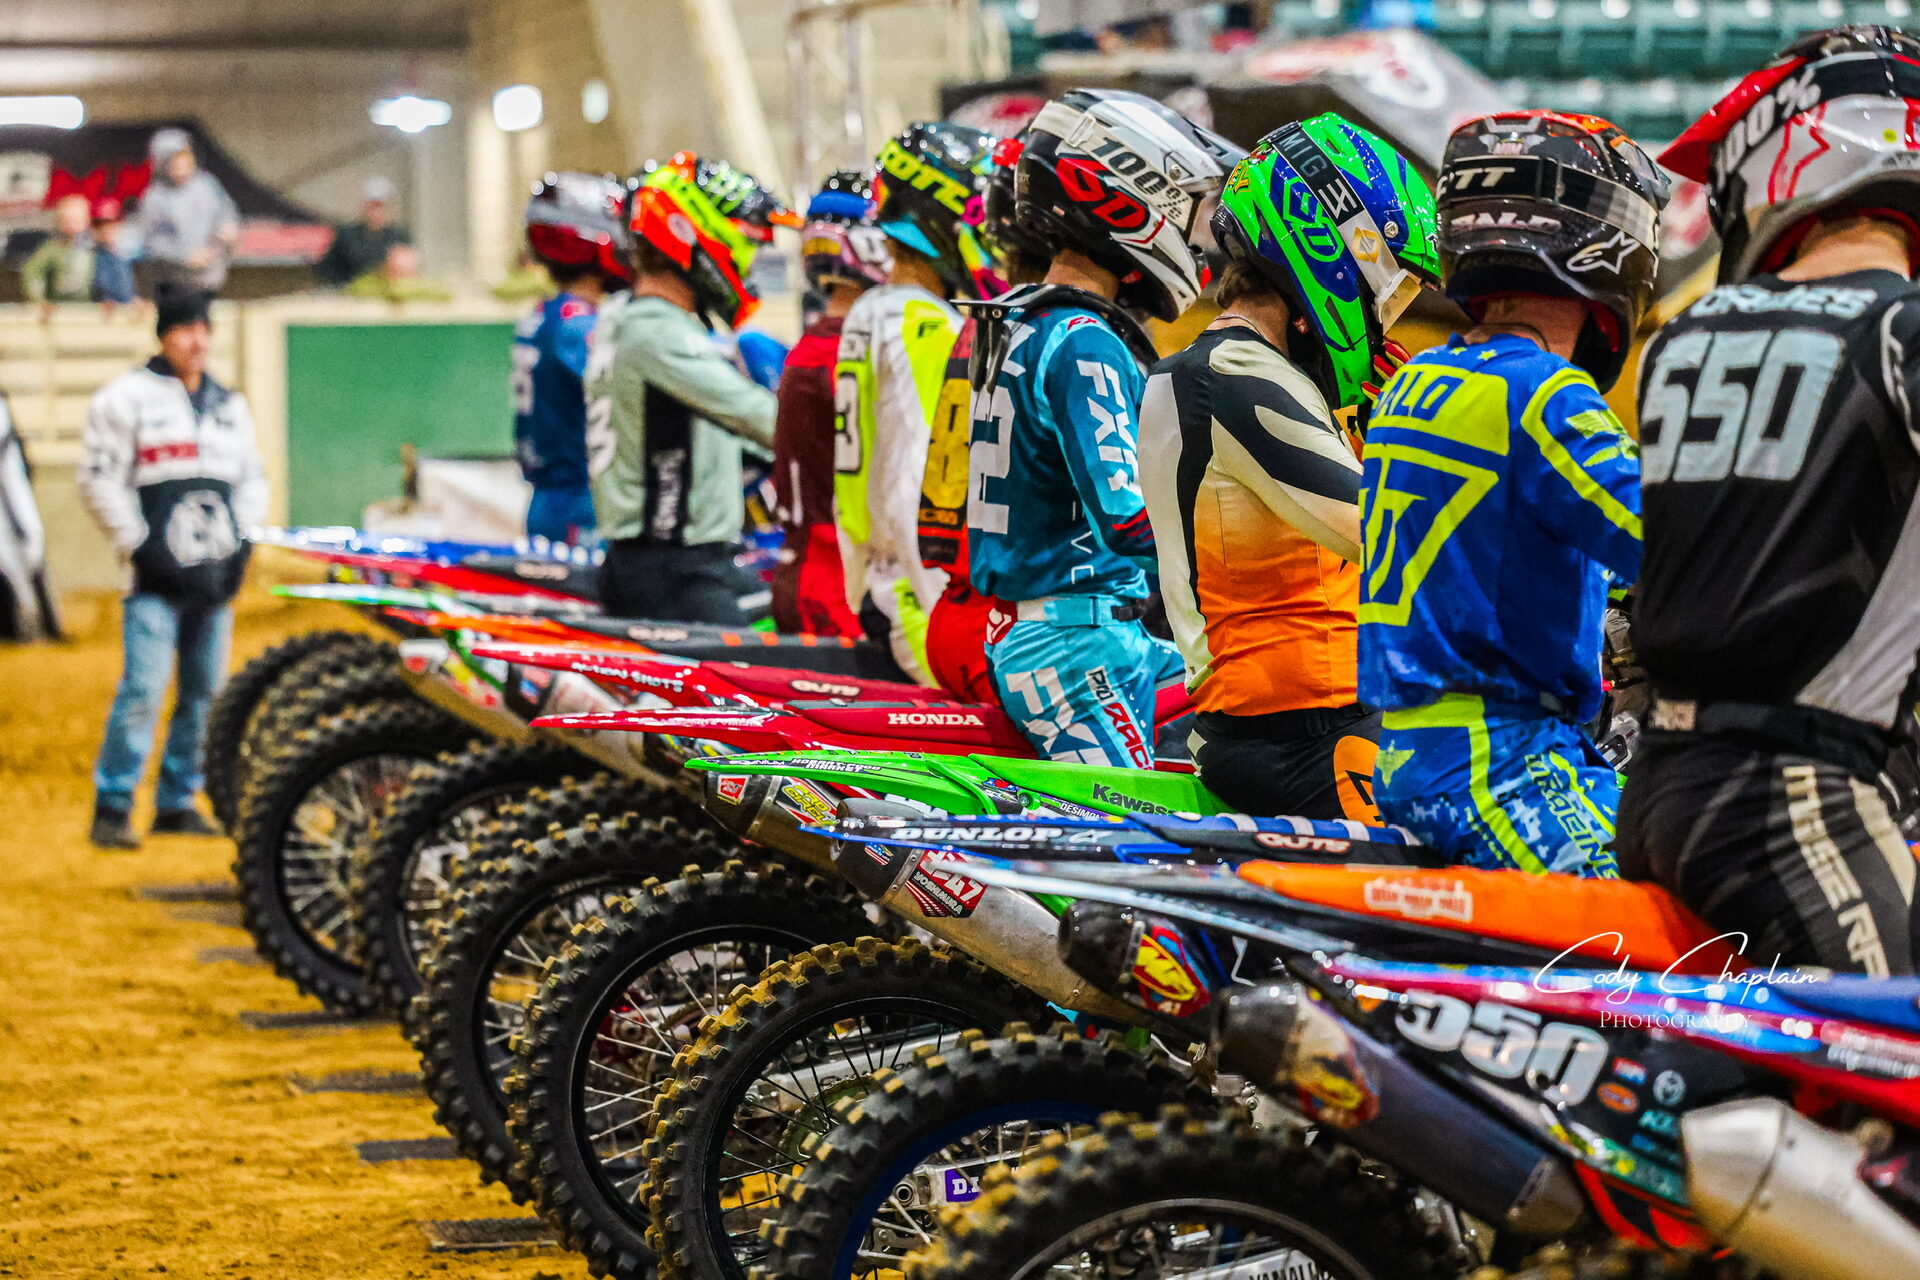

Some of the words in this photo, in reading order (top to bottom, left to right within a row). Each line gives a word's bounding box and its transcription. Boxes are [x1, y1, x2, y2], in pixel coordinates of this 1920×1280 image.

[1093, 135, 1192, 221] 100%
[1278, 130, 1328, 178] MIG
[1640, 327, 1845, 486] 550
[887, 713, 984, 726] HONDA
[889, 825, 1064, 842] DUNLOP
[913, 870, 964, 915] YOSHIMURA
[1394, 987, 1610, 1107] 950
